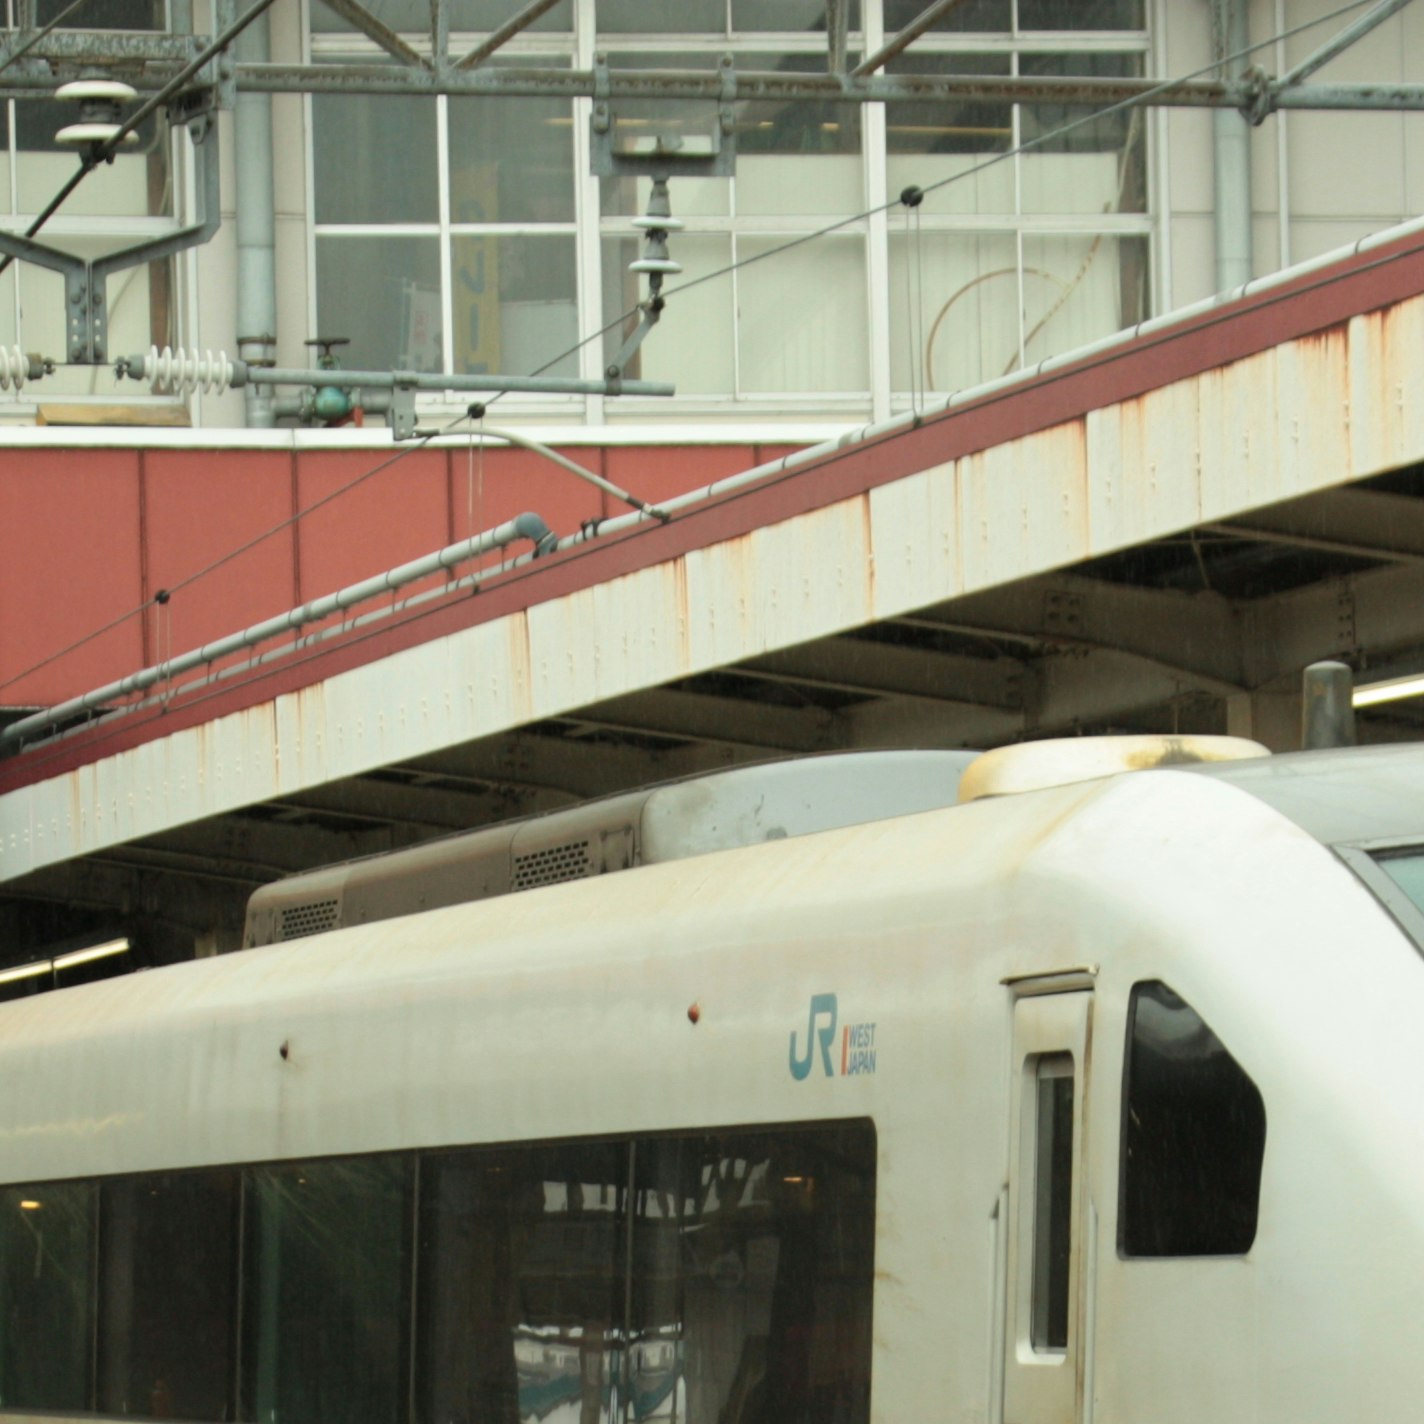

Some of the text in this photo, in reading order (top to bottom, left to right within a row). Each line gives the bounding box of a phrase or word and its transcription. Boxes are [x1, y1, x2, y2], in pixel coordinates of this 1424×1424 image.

[789, 992, 838, 1081] JR
[849, 1022, 876, 1047] WEST
[846, 1049, 875, 1074] JAPAN
